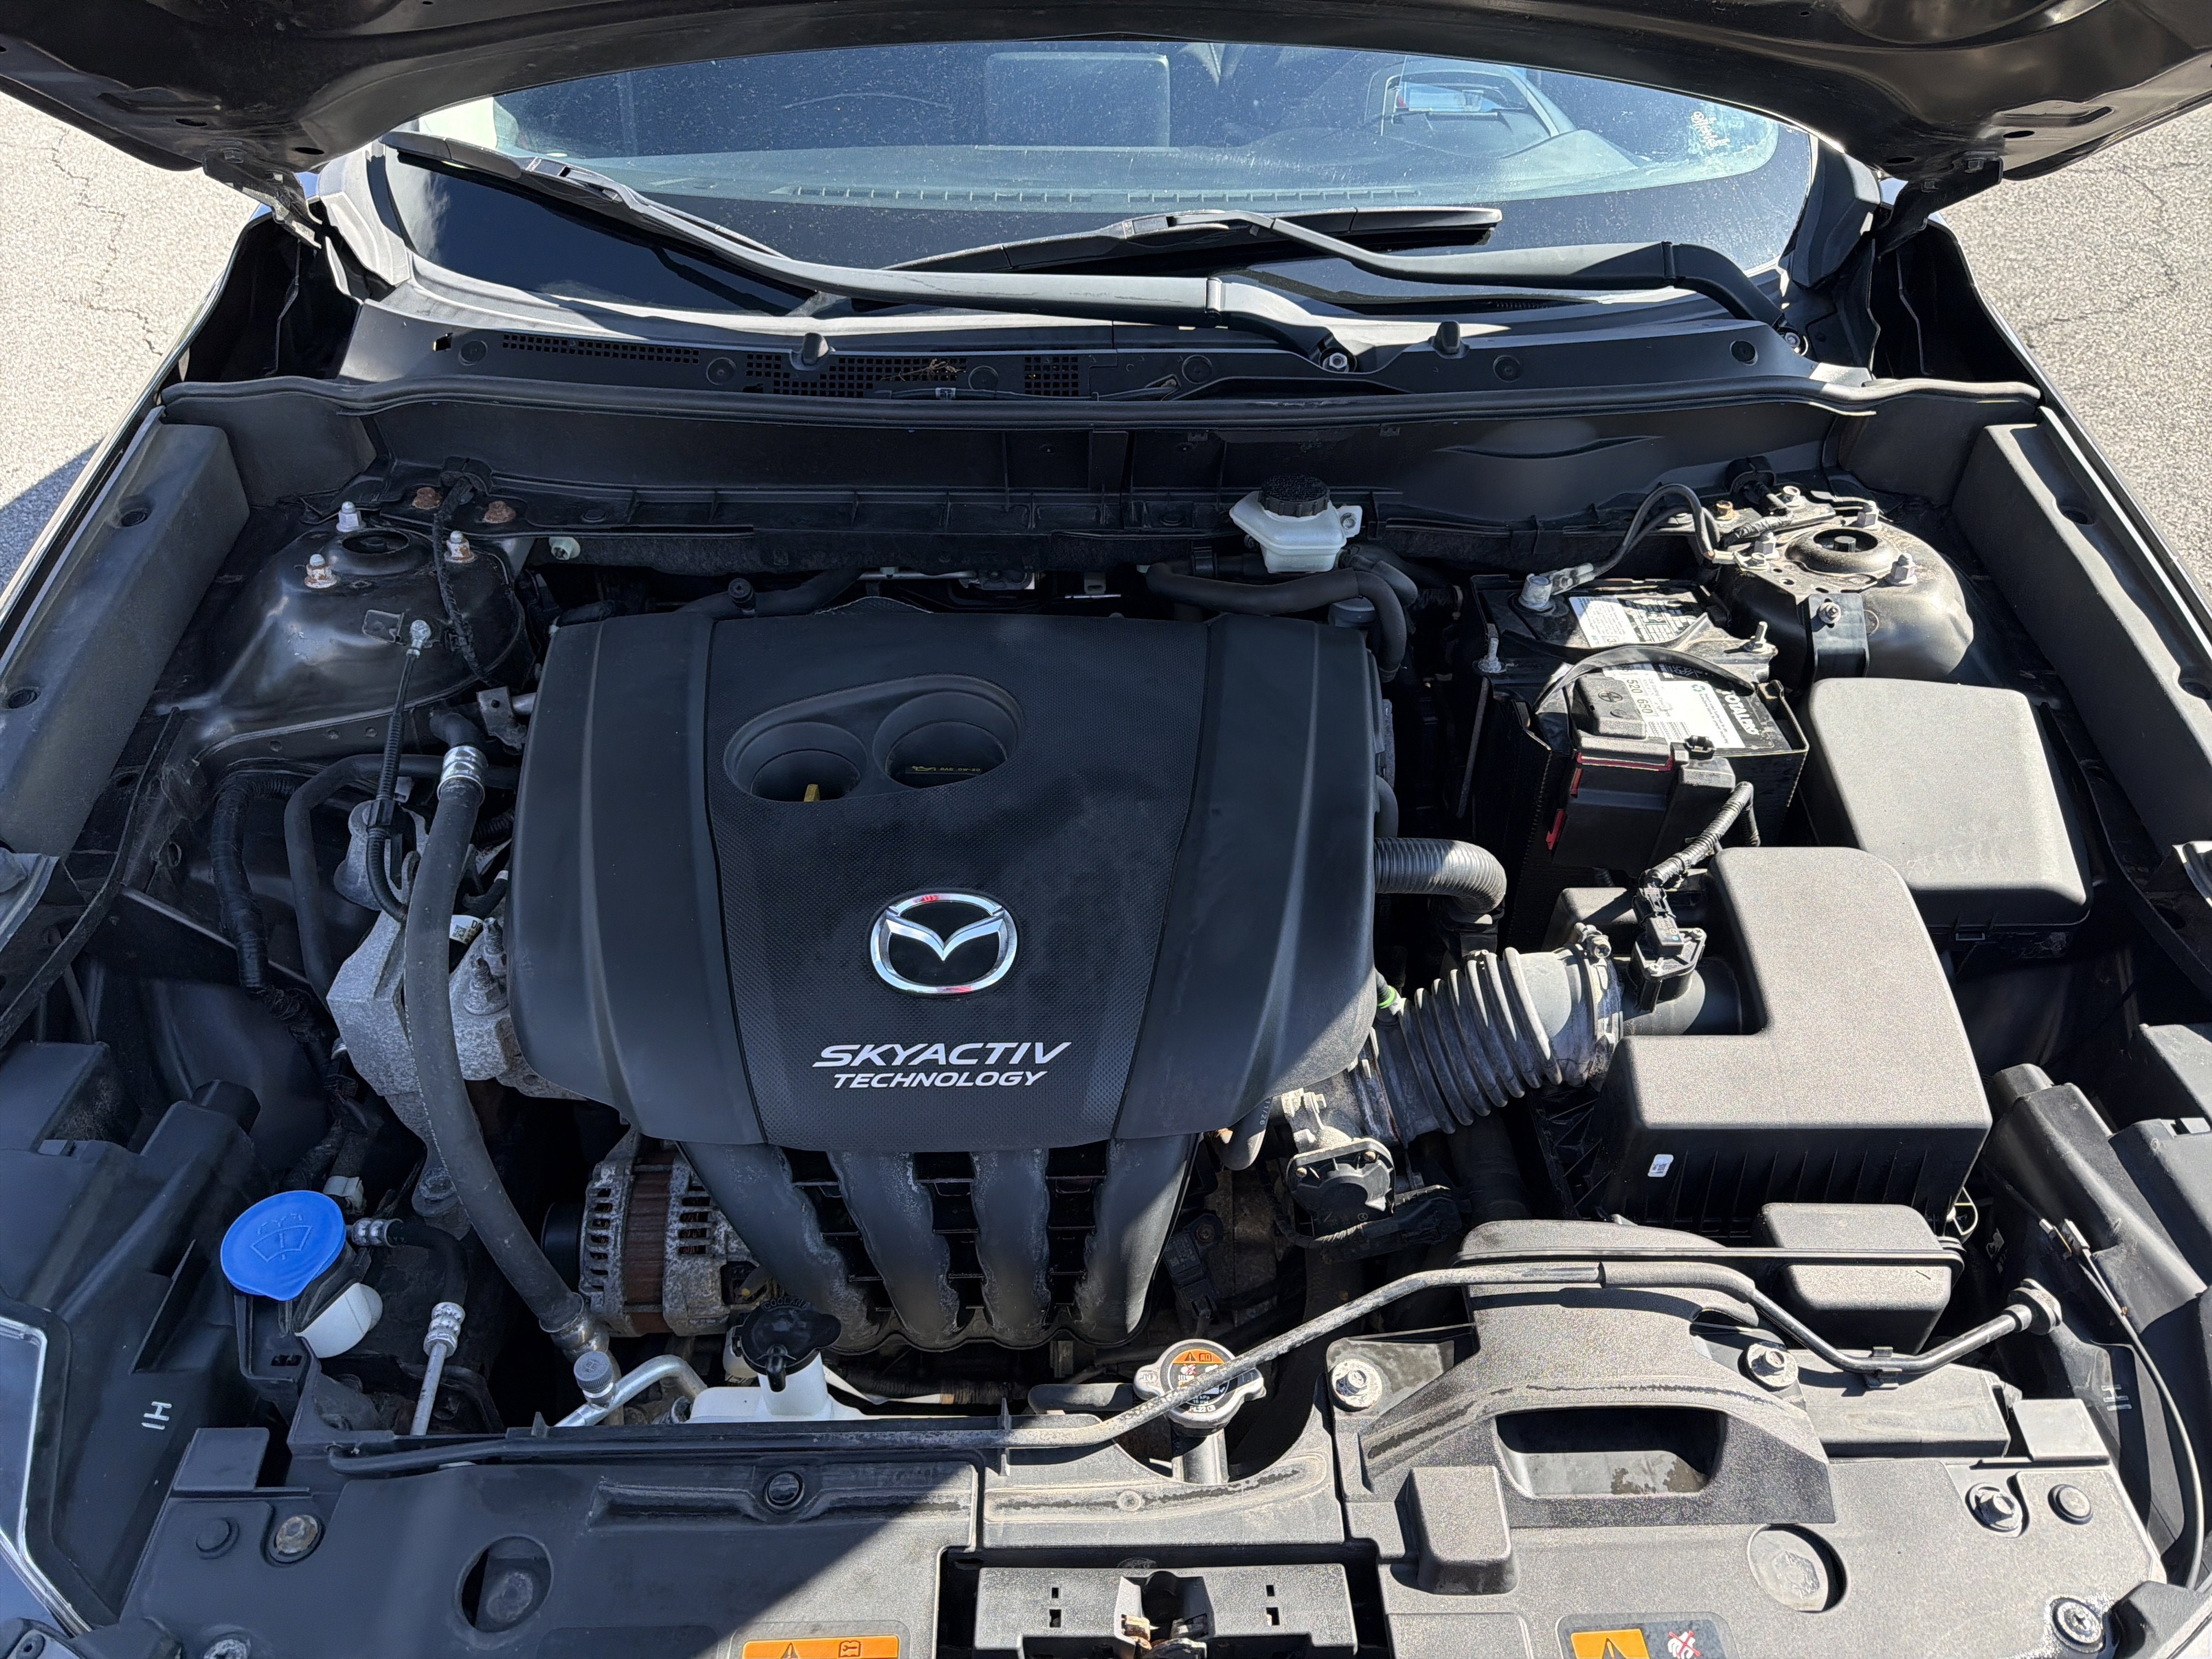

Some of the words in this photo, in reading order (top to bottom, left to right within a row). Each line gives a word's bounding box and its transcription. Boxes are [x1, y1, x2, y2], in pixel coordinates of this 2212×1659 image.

[1627, 679, 1643, 693] 520
[1637, 699, 1654, 714] 650
[812, 1041, 1071, 1068] SKYACTIV
[833, 1071, 1048, 1089] TECHNOLOGY
